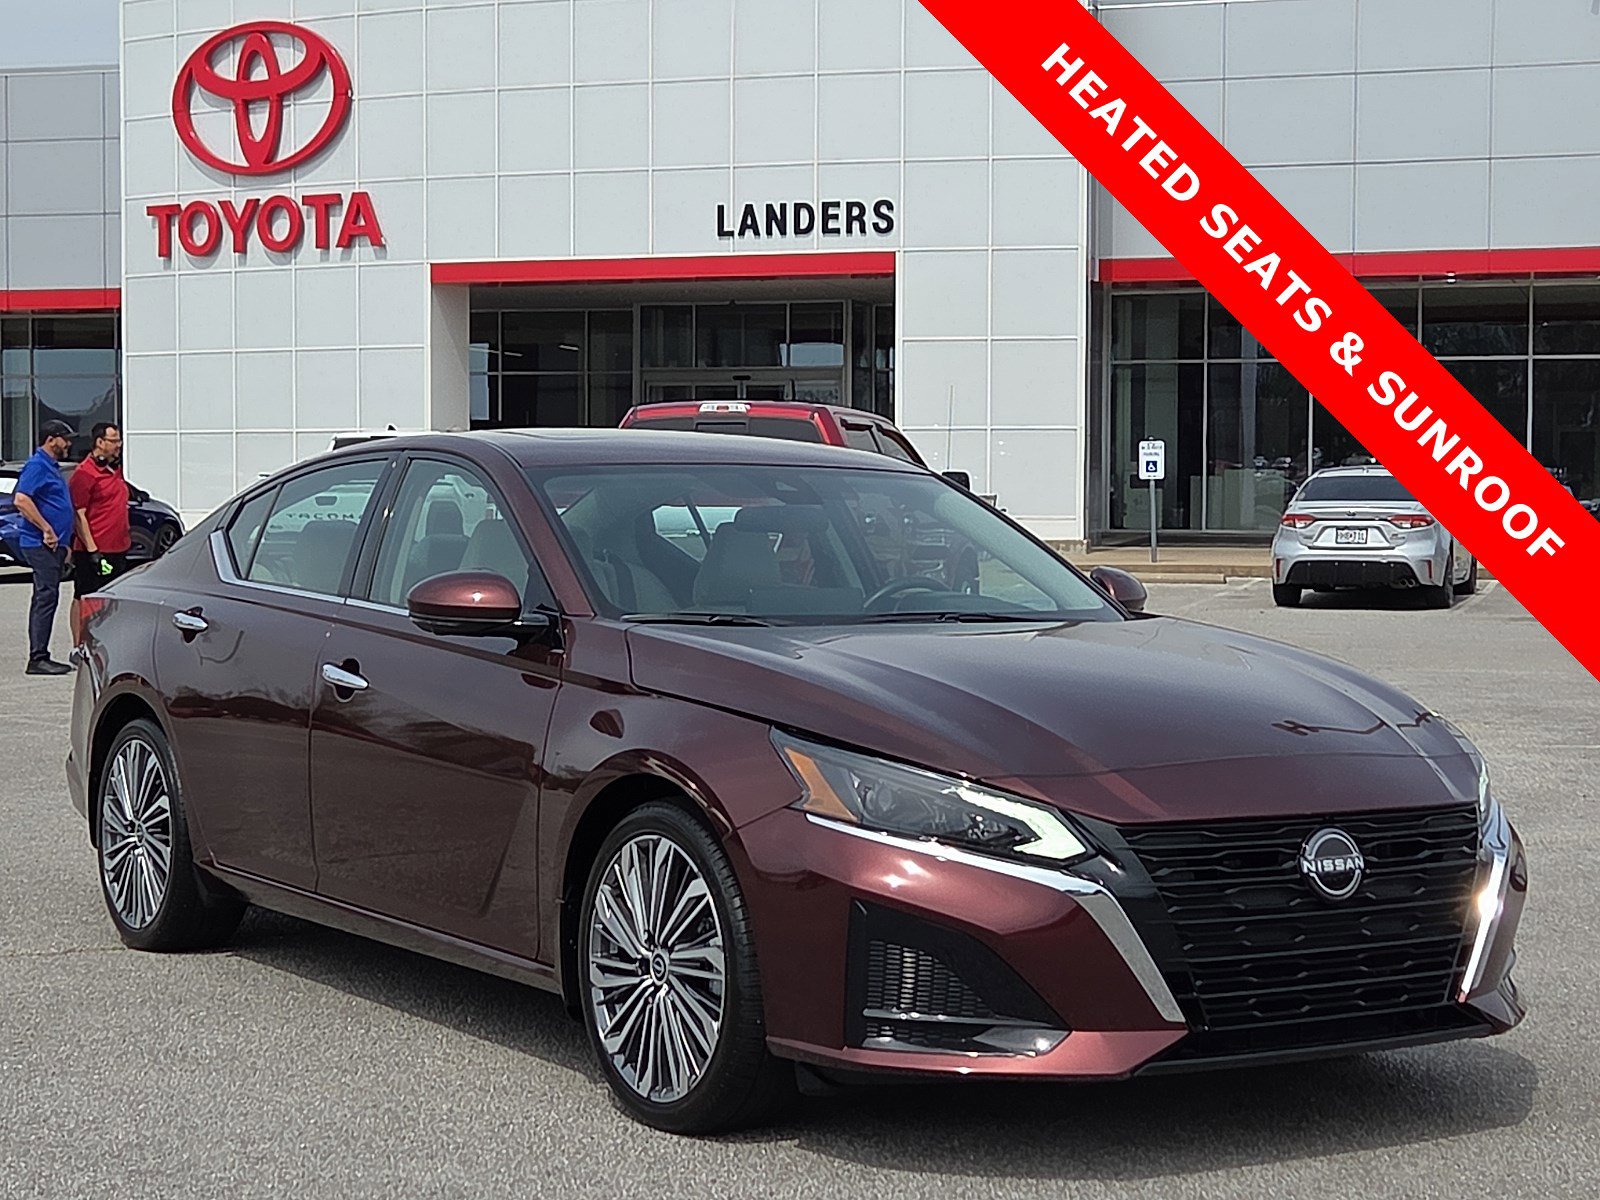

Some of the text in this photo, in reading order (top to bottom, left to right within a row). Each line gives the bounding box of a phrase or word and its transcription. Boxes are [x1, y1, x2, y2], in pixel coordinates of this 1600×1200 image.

[147, 191, 387, 258] TOYOTA
[717, 199, 895, 238] LANDERS
[1302, 856, 1364, 873] NISSAN
